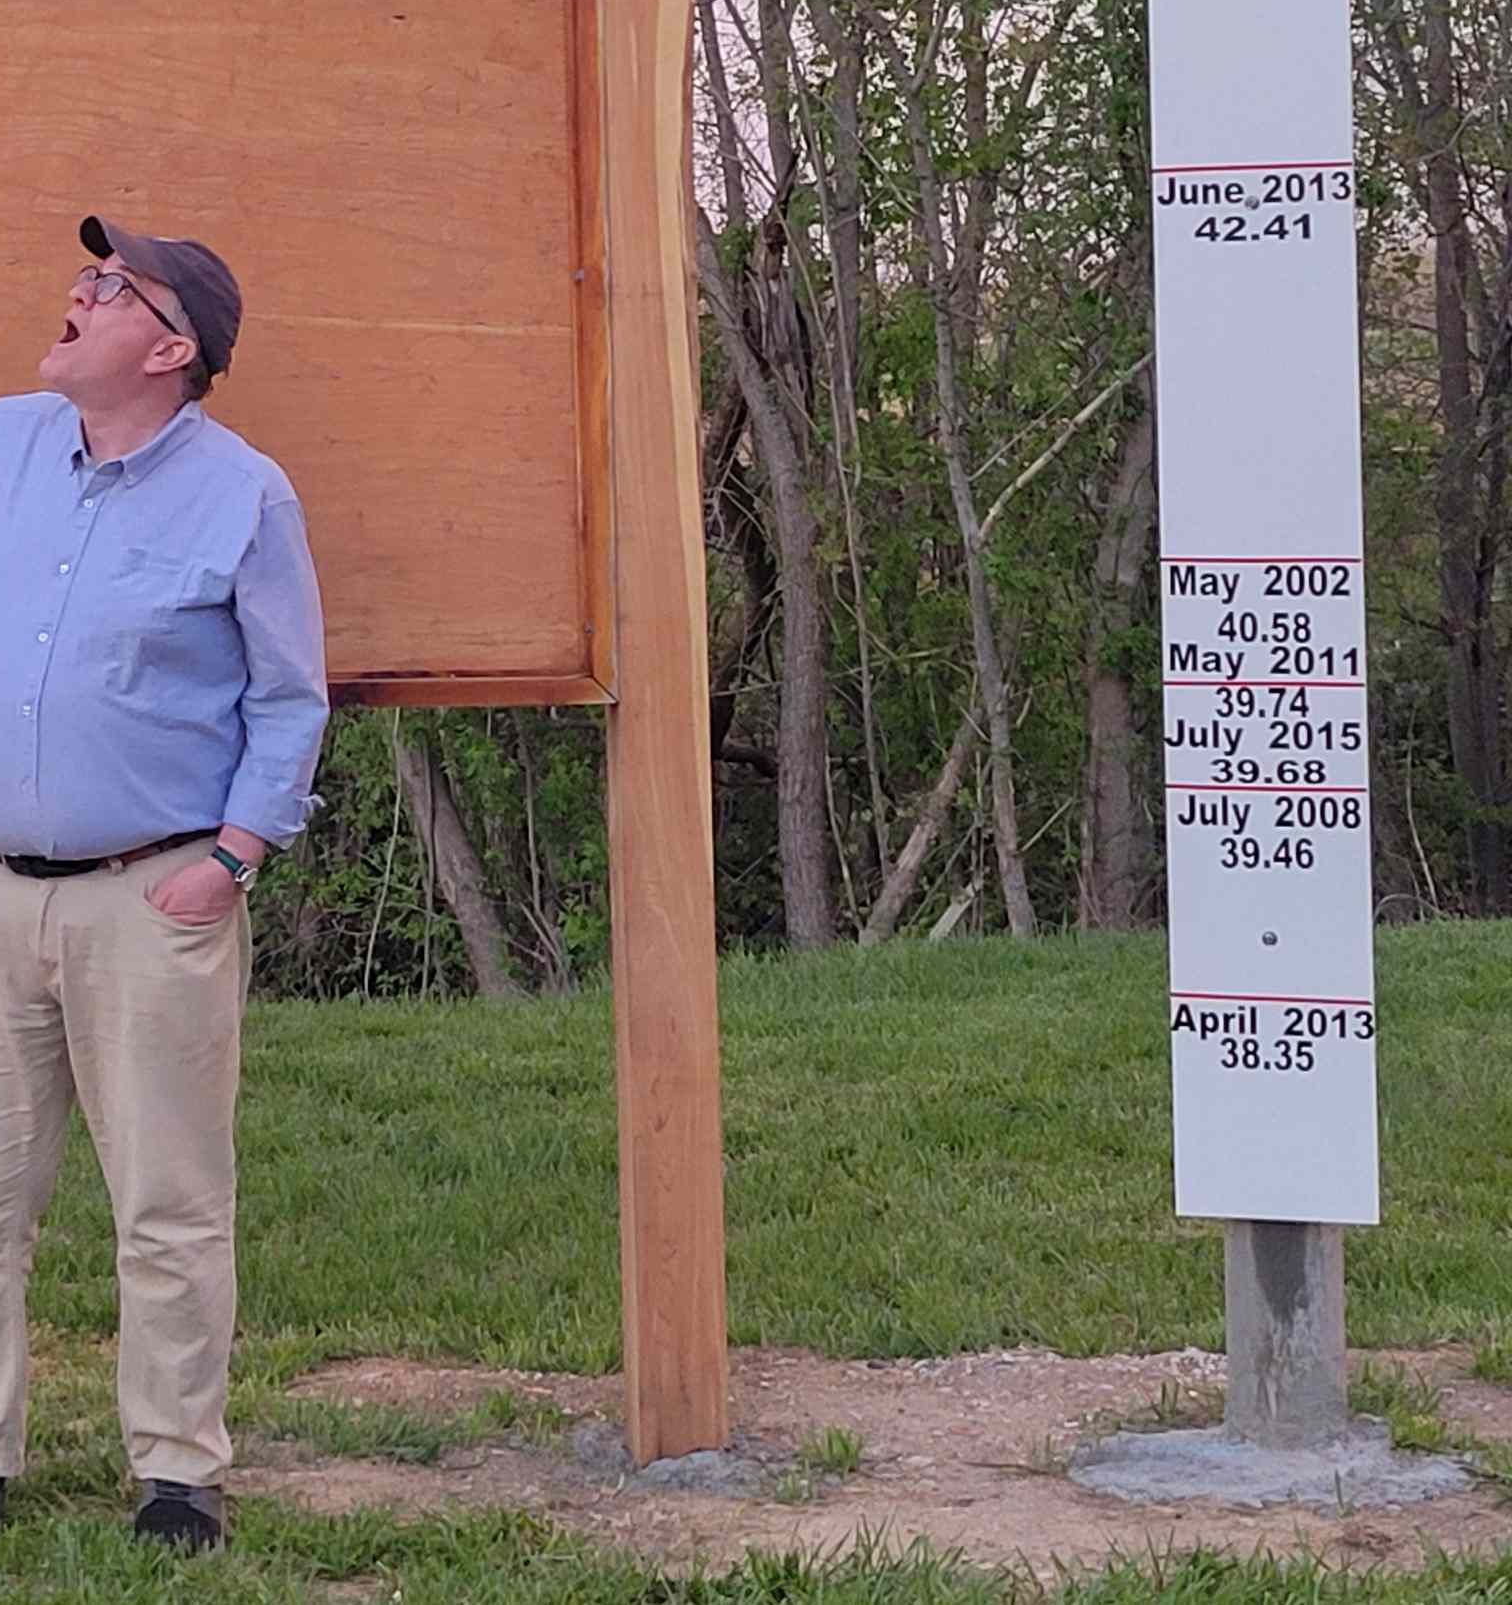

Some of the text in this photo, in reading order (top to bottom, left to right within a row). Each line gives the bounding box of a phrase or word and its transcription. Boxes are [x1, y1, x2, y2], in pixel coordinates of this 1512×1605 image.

[1157, 172, 1351, 207] June 2013
[1195, 214, 1312, 242] 42.41
[1169, 565, 1350, 604] May 2002
[1218, 612, 1311, 643] 40.58
[1169, 644, 1358, 680] May 2011
[1216, 687, 1309, 718] 39.74
[1164, 719, 1361, 756] July 2015
[1211, 760, 1325, 784] 39.68
[1178, 795, 1361, 834] July 2008
[1221, 838, 1314, 869] 39.46
[1171, 1004, 1374, 1040] April 2013
[1221, 1039, 1314, 1071] 38.35
